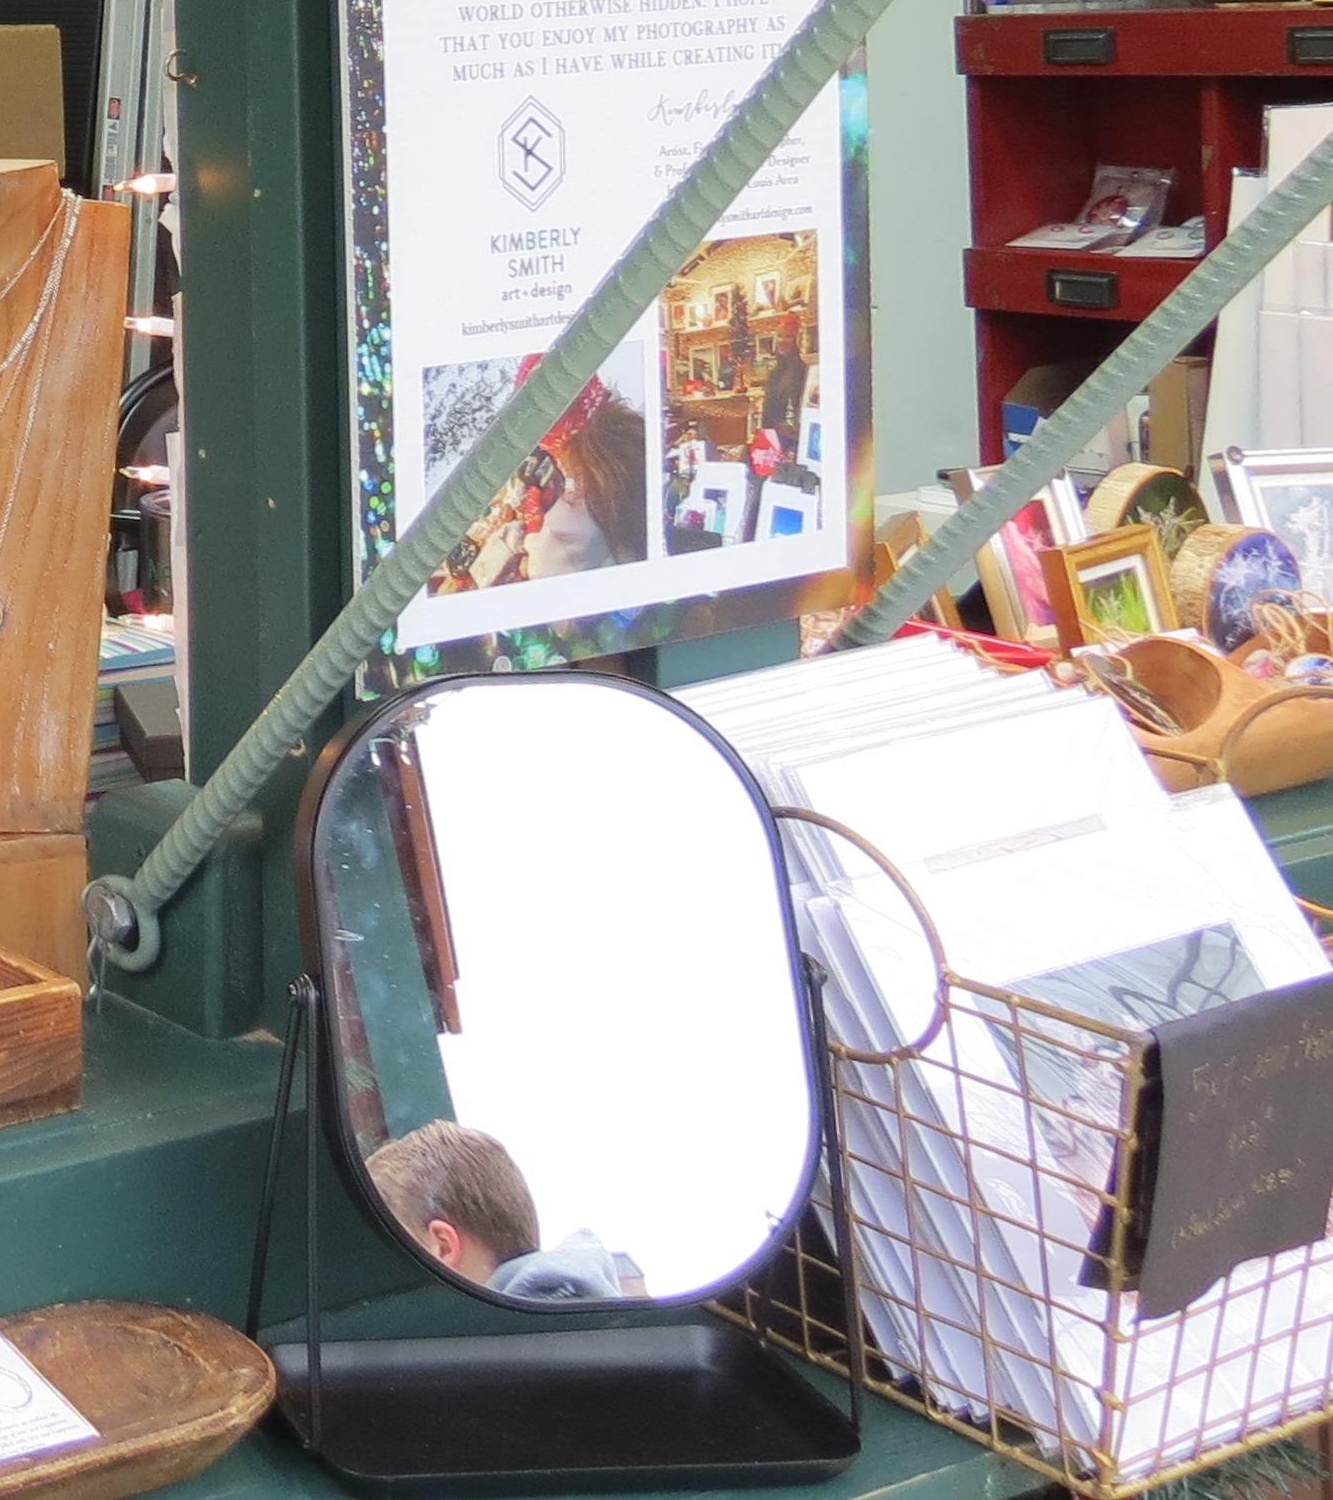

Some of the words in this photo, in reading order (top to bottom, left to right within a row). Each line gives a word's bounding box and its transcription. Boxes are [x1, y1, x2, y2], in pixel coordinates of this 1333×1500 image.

[457, 1, 524, 23] WORLD
[438, 33, 492, 54] THAT
[495, 30, 535, 49] YOU
[541, 26, 596, 47] ENJOY
[602, 24, 629, 42] MY
[635, 16, 759, 40] PHOTOGRAPHY
[764, 15, 785, 31] AS
[452, 61, 505, 81] MUCH
[512, 59, 535, 77] AS
[554, 54, 603, 74] HAVE
[609, 50, 667, 69] WHILE
[671, 44, 755, 66] CREATING
[490, 226, 581, 254] KIMBERLY
[507, 253, 564, 278] SMITH
[460, 310, 575, 336] kimberlysmithartdes
